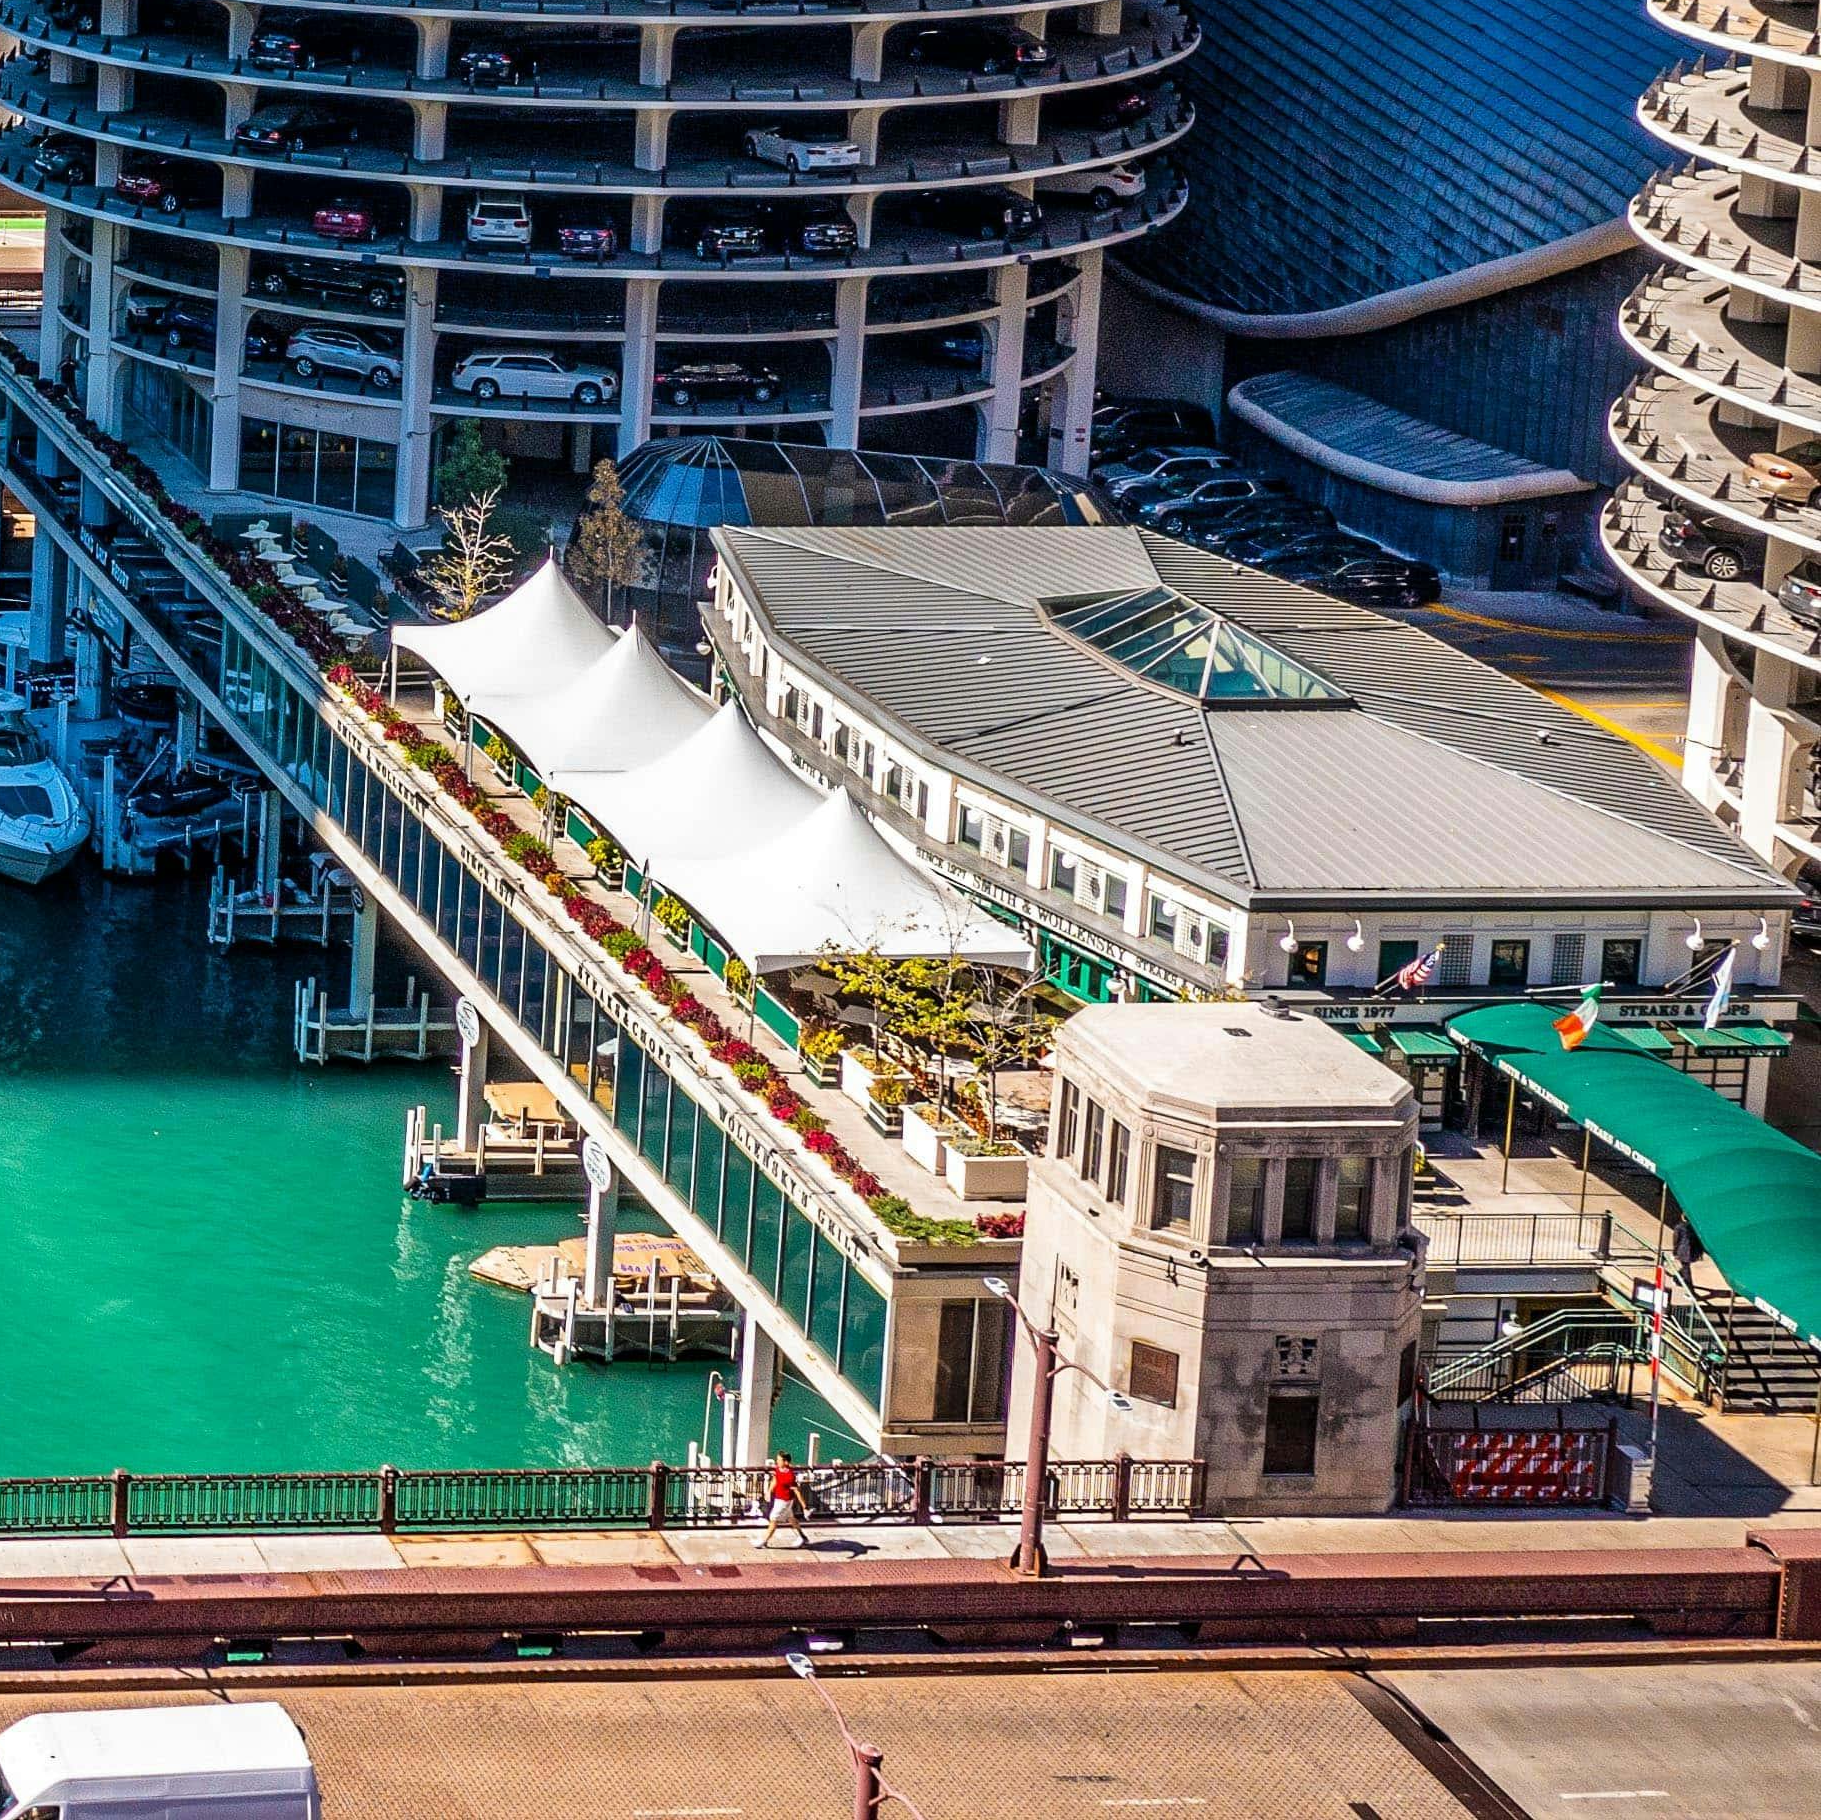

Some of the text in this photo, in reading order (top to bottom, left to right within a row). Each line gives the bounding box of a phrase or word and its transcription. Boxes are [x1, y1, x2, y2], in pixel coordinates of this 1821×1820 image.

[916, 845, 944, 871] SINCE
[972, 874, 1017, 908] SMITH
[1021, 899, 1032, 915] &
[1037, 904, 1126, 964] WOLLENSKY
[1134, 956, 1179, 984] STEAKS
[1313, 1006, 1396, 1019] SINCE 1977
[1619, 1004, 1679, 1017] STEAKS
[1684, 1005, 1695, 1016] &
